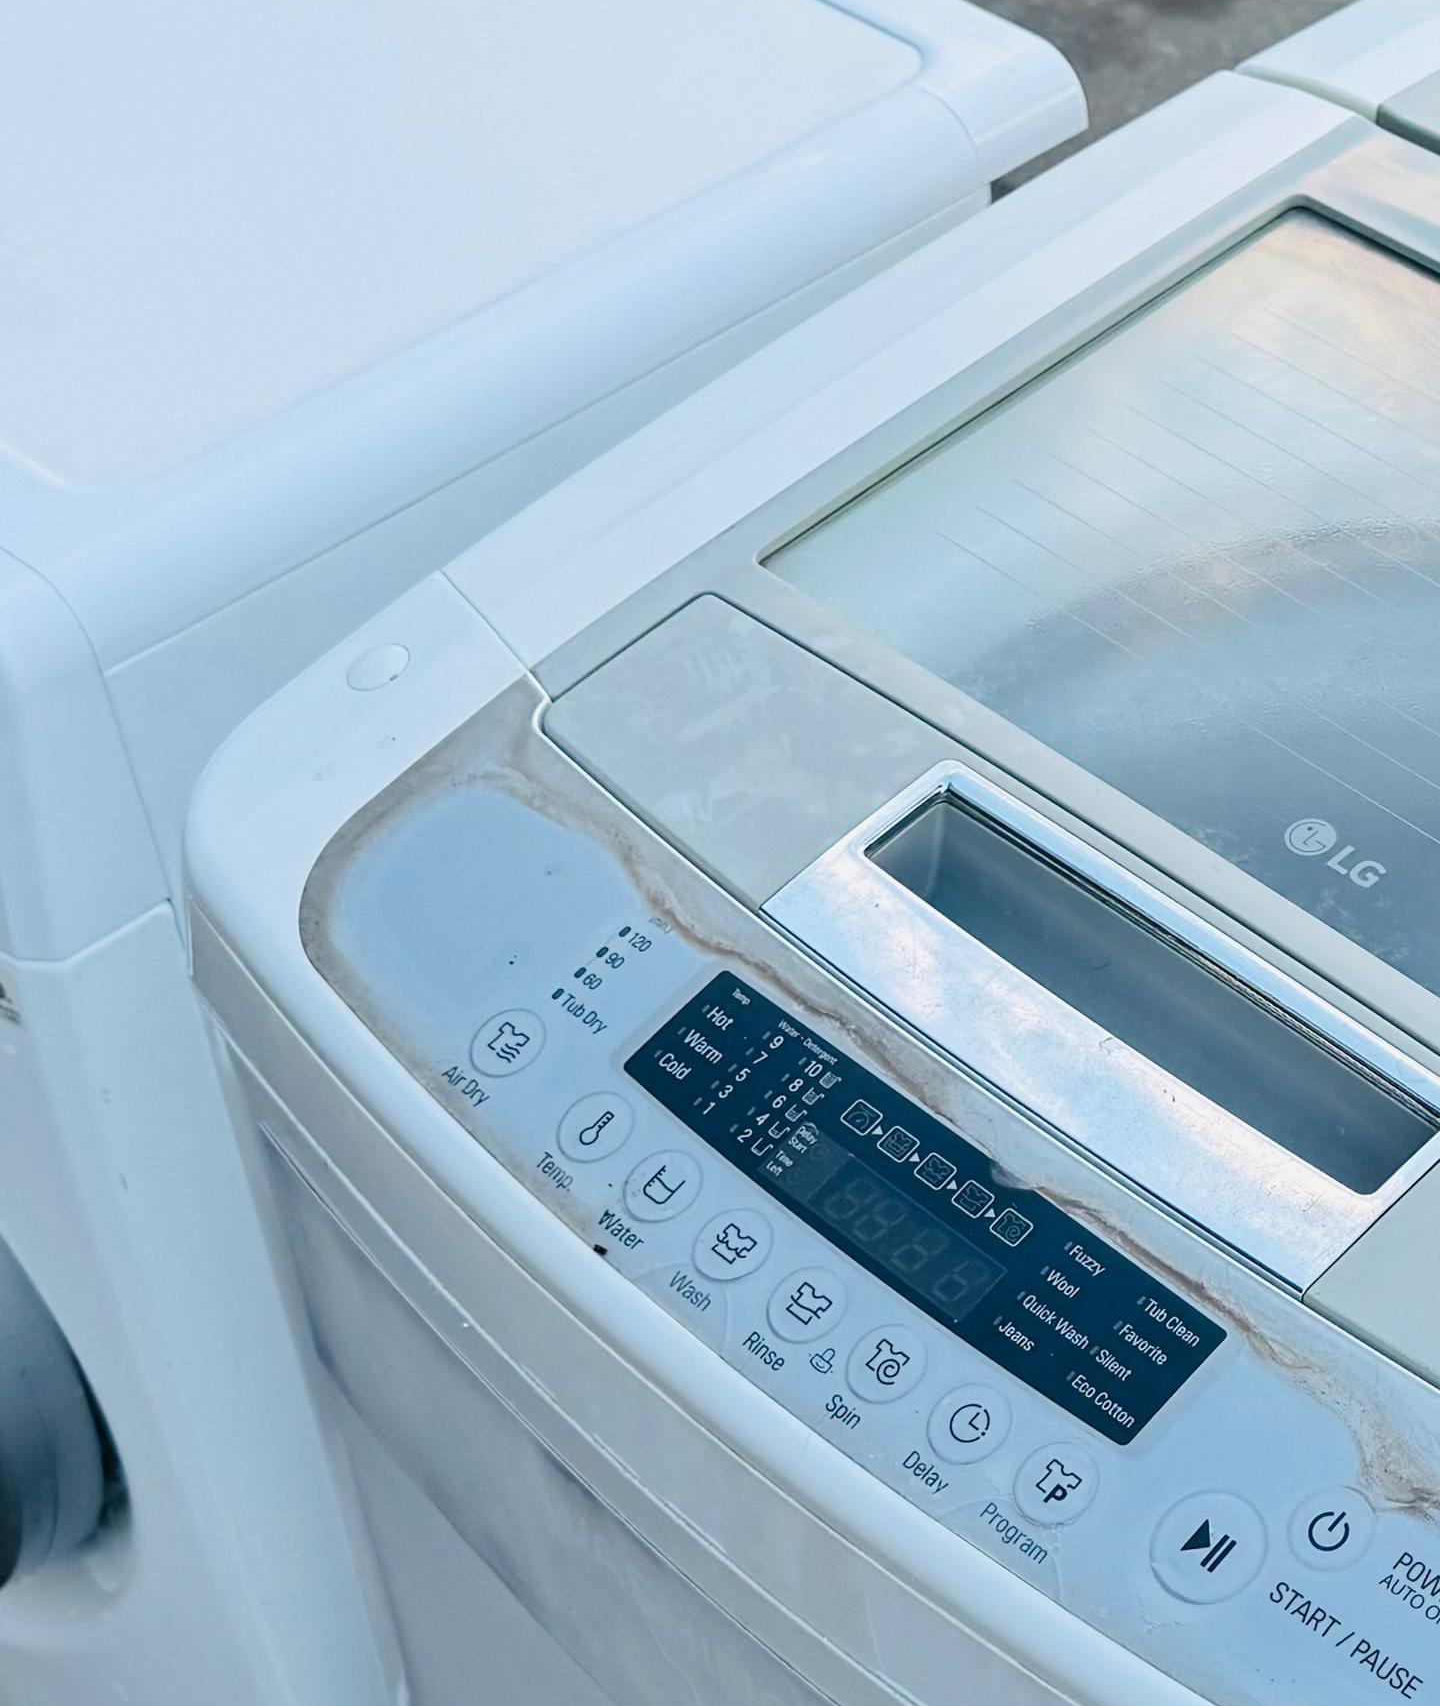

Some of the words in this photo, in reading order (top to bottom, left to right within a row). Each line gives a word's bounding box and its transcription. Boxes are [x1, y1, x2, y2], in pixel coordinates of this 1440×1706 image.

[1326, 845, 1387, 889] LG
[628, 933, 652, 952] 120
[605, 952, 625, 969] 90
[582, 973, 602, 990] 60
[561, 993, 585, 1018] Tub
[582, 1011, 608, 1035] Dry
[706, 1006, 734, 1031] Hot
[778, 1019, 801, 1040] Water
[684, 1029, 723, 1064] Warm
[752, 1051, 769, 1065] 7
[769, 1035, 784, 1050] 9
[658, 1052, 692, 1080] Cold
[735, 1068, 751, 1082] 5
[804, 1060, 823, 1078] 10
[441, 1065, 466, 1087] Air
[462, 1078, 490, 1107] Dry
[718, 1085, 734, 1099] 3
[788, 1078, 804, 1092] 8
[702, 1102, 716, 1115] 1
[772, 1095, 787, 1109] 6
[737, 1128, 752, 1143] 2
[756, 1113, 770, 1126] 4
[598, 1209, 644, 1250] Water
[1069, 1245, 1106, 1277] Fuzzy
[669, 1271, 712, 1312] Wash
[1046, 1269, 1081, 1299] Wool
[998, 1321, 1036, 1353] Jeans
[1022, 1294, 1057, 1325] Quick
[1054, 1316, 1090, 1350] Wash
[1144, 1297, 1167, 1323] Tub
[1166, 1316, 1201, 1348] Clean
[742, 1331, 785, 1372] Rinse
[1118, 1323, 1168, 1366] Favorite
[1096, 1350, 1132, 1382] Silent
[825, 1394, 862, 1430] Spin
[1071, 1375, 1096, 1398] Eco
[1094, 1392, 1135, 1429] Cotton
[903, 1451, 950, 1495] Delay
[980, 1502, 1048, 1565] Program
[1378, 1574, 1425, 1611] AUTO
[1268, 1581, 1342, 1637] START
[1350, 1638, 1424, 1699] PAUSE
